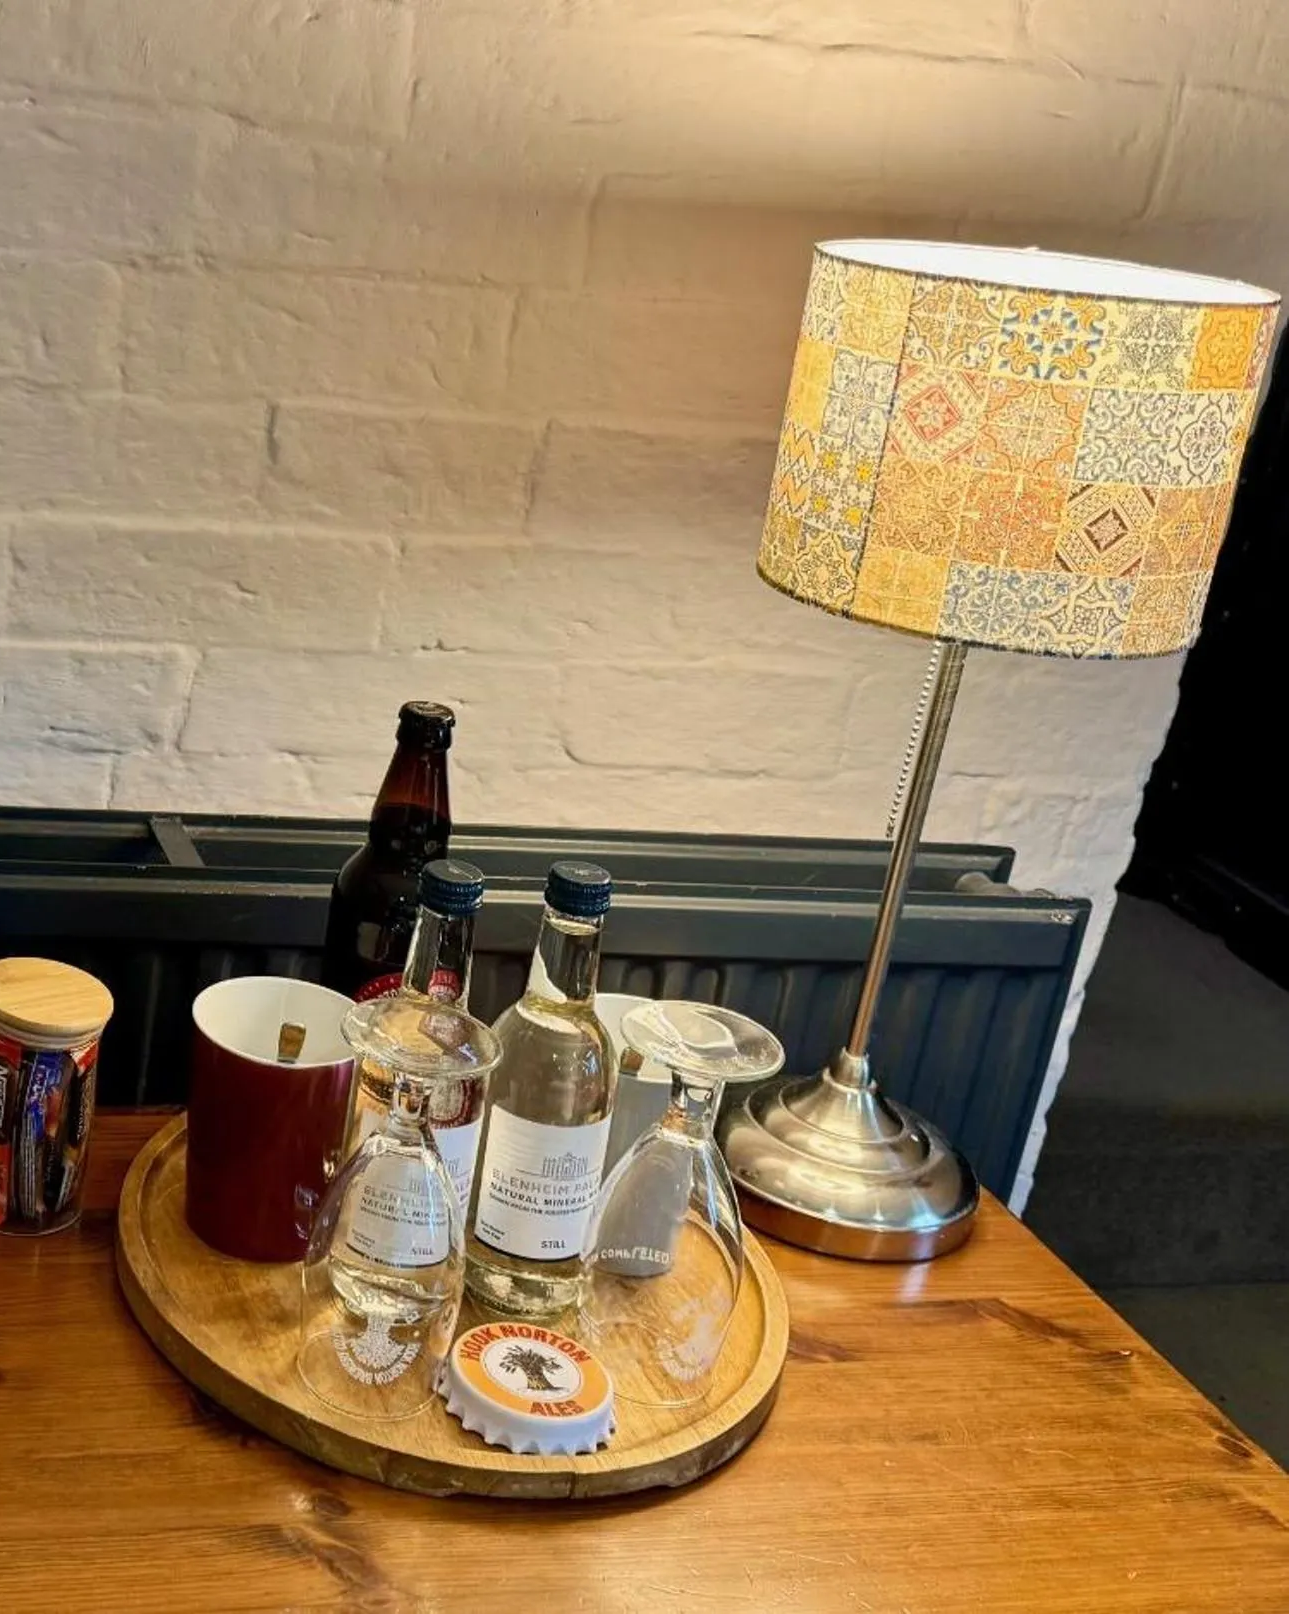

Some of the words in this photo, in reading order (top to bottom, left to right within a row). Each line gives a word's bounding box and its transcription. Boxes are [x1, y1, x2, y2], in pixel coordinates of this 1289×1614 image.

[491, 1181, 539, 1206] NATURAL
[544, 1196, 586, 1207] MINERAL
[492, 1168, 570, 1196] BLENHEIM
[540, 1240, 566, 1249] STILL
[460, 1327, 500, 1362] HOOK
[499, 1324, 592, 1363] NORTON
[529, 1400, 585, 1417] ALES
